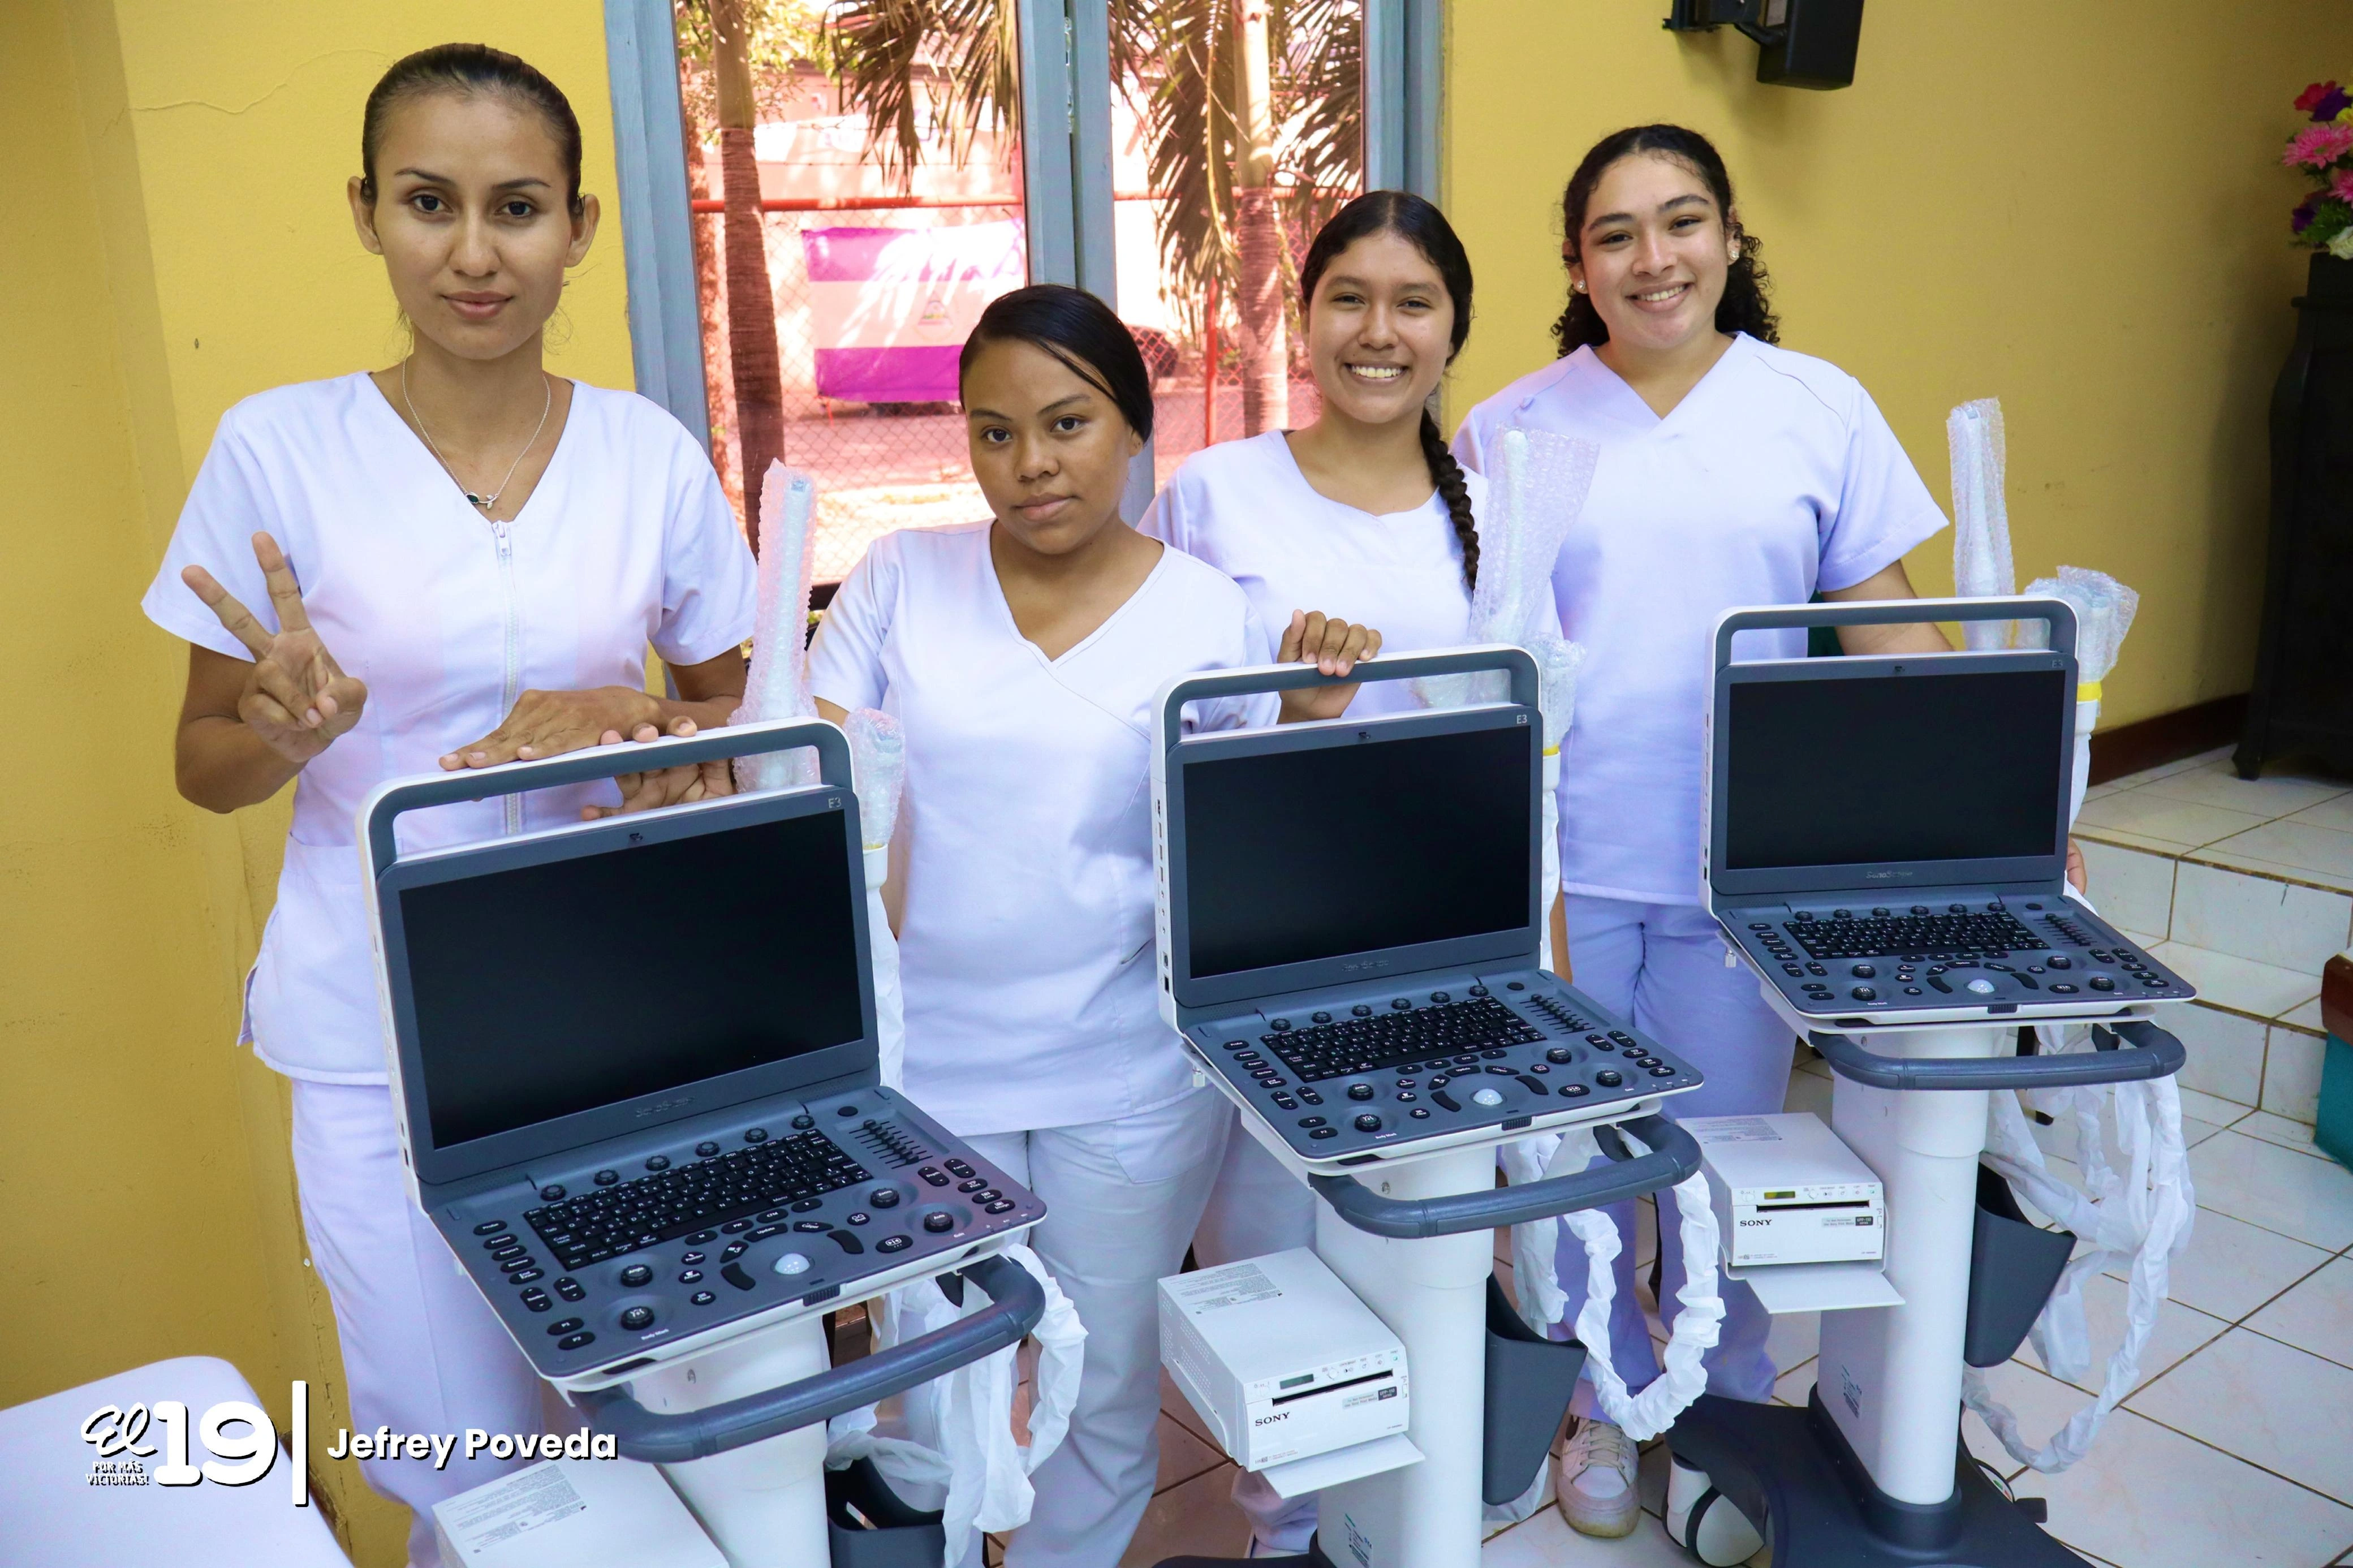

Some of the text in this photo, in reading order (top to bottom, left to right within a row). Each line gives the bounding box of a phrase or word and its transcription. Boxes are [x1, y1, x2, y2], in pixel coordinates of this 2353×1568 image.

[2052, 660, 2063, 668] E3
[1516, 714, 1527, 725] E3
[828, 798, 841, 808] E3
[508, 1259, 528, 1267] Review
[1255, 1412, 1290, 1427] SONY
